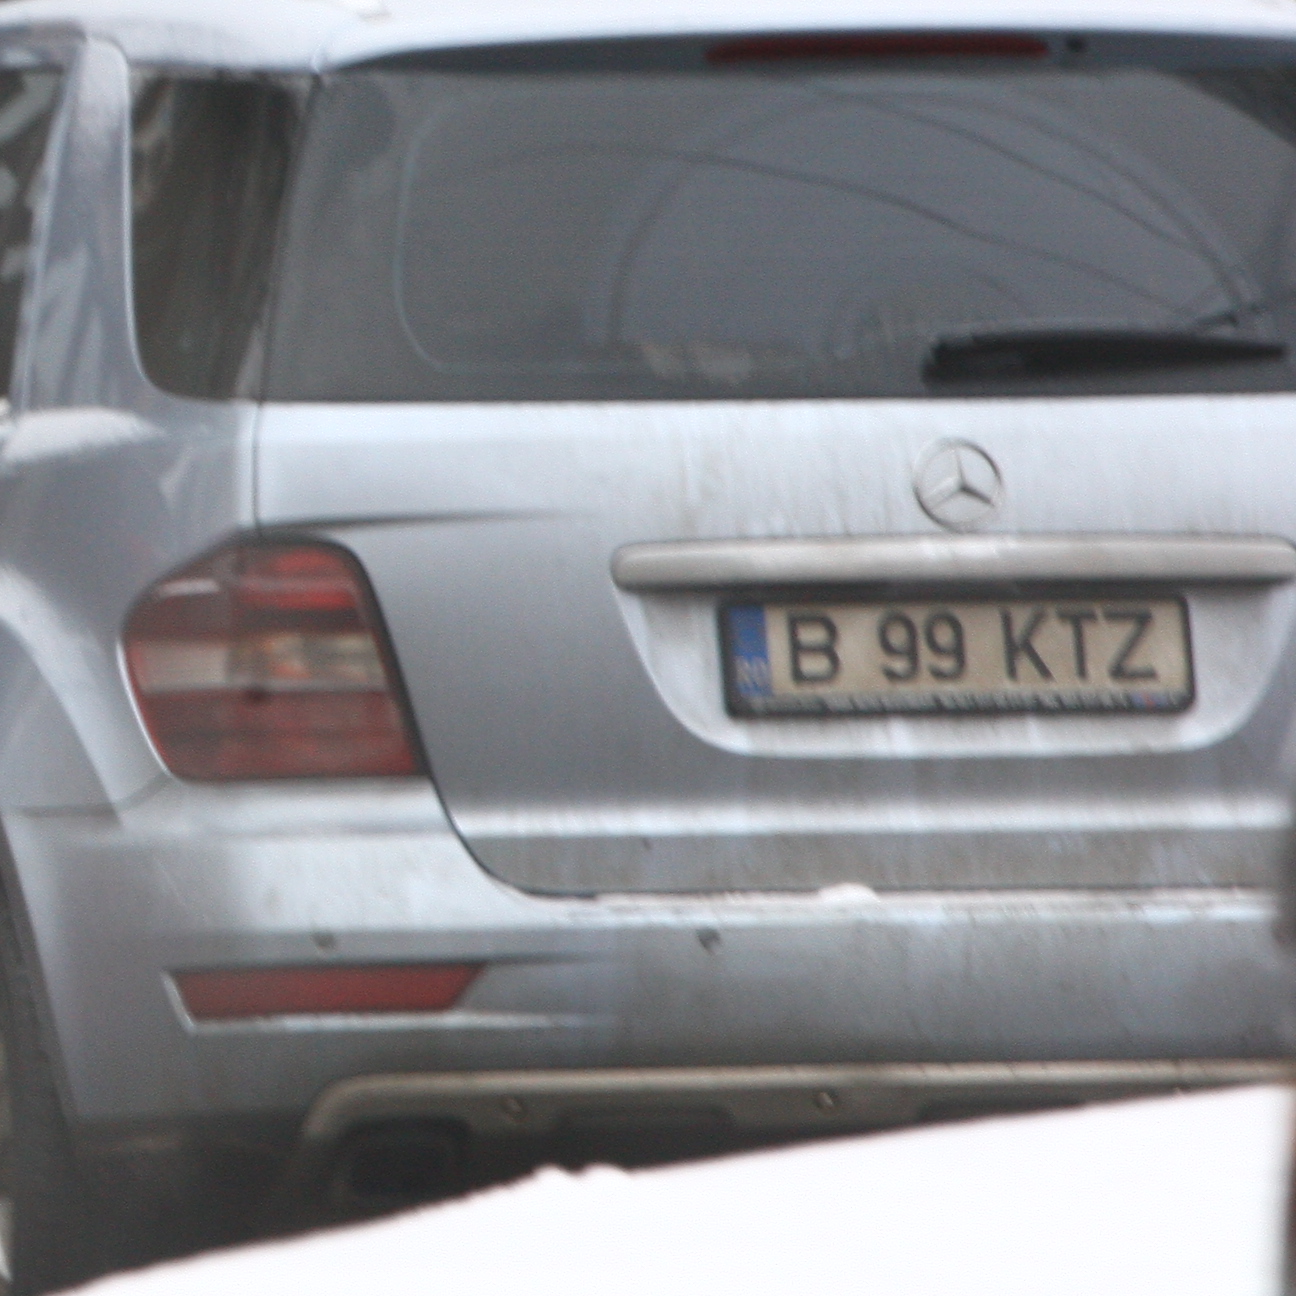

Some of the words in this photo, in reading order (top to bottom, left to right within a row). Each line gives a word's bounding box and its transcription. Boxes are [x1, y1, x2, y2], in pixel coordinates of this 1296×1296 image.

[788, 612, 840, 683] B
[877, 611, 967, 682] 99
[1002, 607, 1159, 682] KTZ
